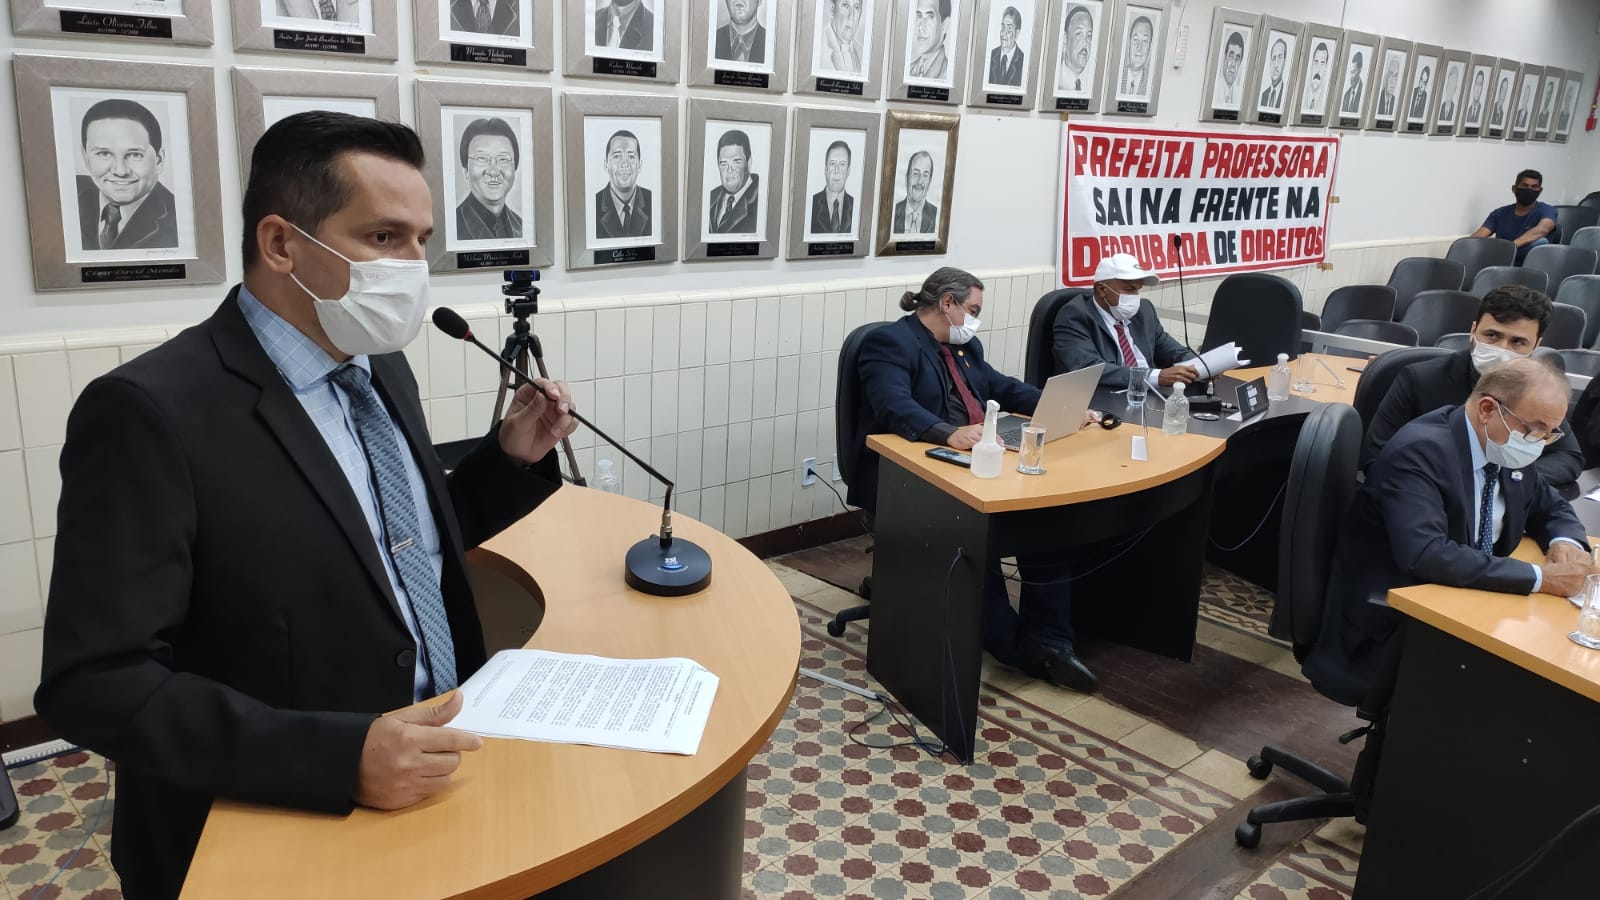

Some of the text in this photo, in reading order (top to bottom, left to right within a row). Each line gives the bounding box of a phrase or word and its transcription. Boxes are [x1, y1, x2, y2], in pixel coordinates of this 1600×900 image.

[1072, 135, 1329, 179] PREFEITA PROFESSORA
[1093, 186, 1320, 226] SAI NA FRENTE NA
[1213, 230, 1237, 264] DE
[1240, 226, 1324, 262] DIREITOS
